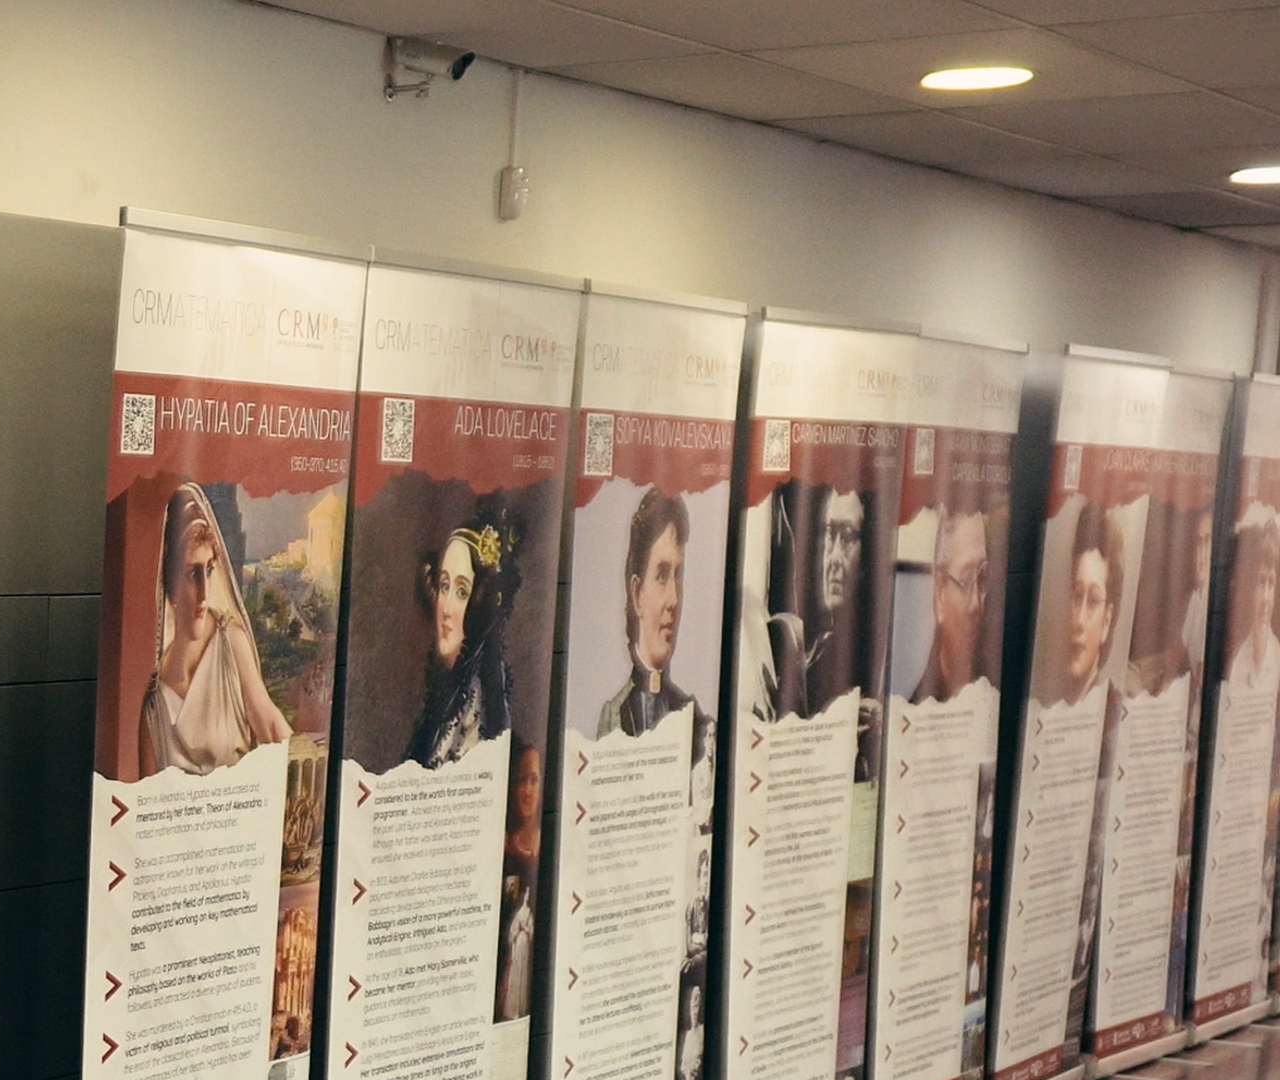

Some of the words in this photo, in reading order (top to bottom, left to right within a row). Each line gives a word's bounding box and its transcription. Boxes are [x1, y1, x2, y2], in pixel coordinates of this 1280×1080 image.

[160, 396, 230, 434] HYPATIA
[234, 401, 255, 435] OF
[257, 405, 351, 442] ALEXANDRIA
[454, 405, 484, 435] ADA
[487, 408, 557, 441] LOVELACE
[616, 417, 652, 445] SOFYA
